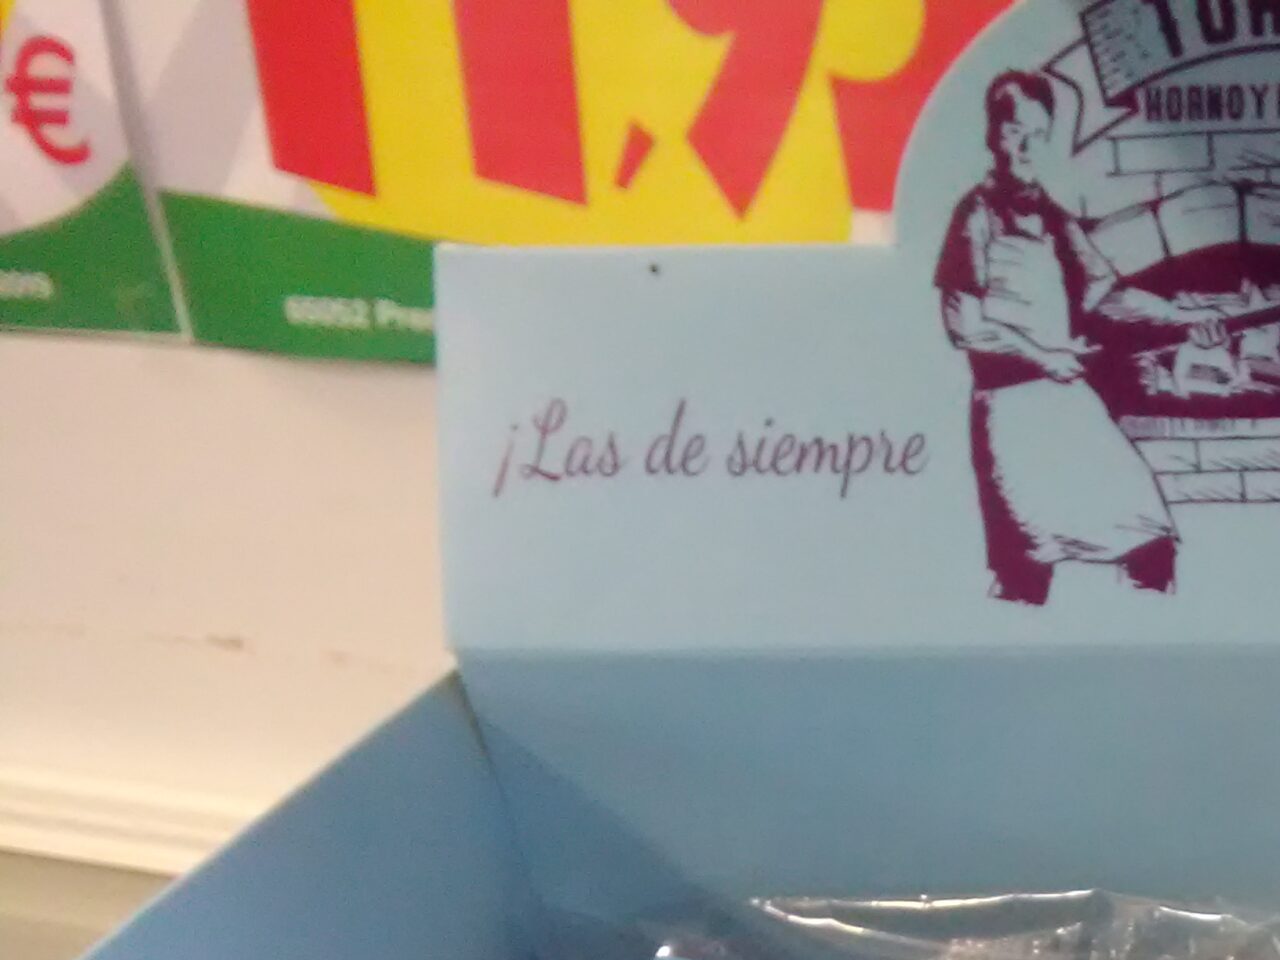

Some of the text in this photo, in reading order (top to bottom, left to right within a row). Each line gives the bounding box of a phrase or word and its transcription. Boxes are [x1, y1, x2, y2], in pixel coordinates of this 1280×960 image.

[4, 34, 92, 166] €
[1144, 81, 1245, 123] HORNO
[1246, 83, 1270, 120] Y
[491, 397, 928, 500] ¡Las de siempre
